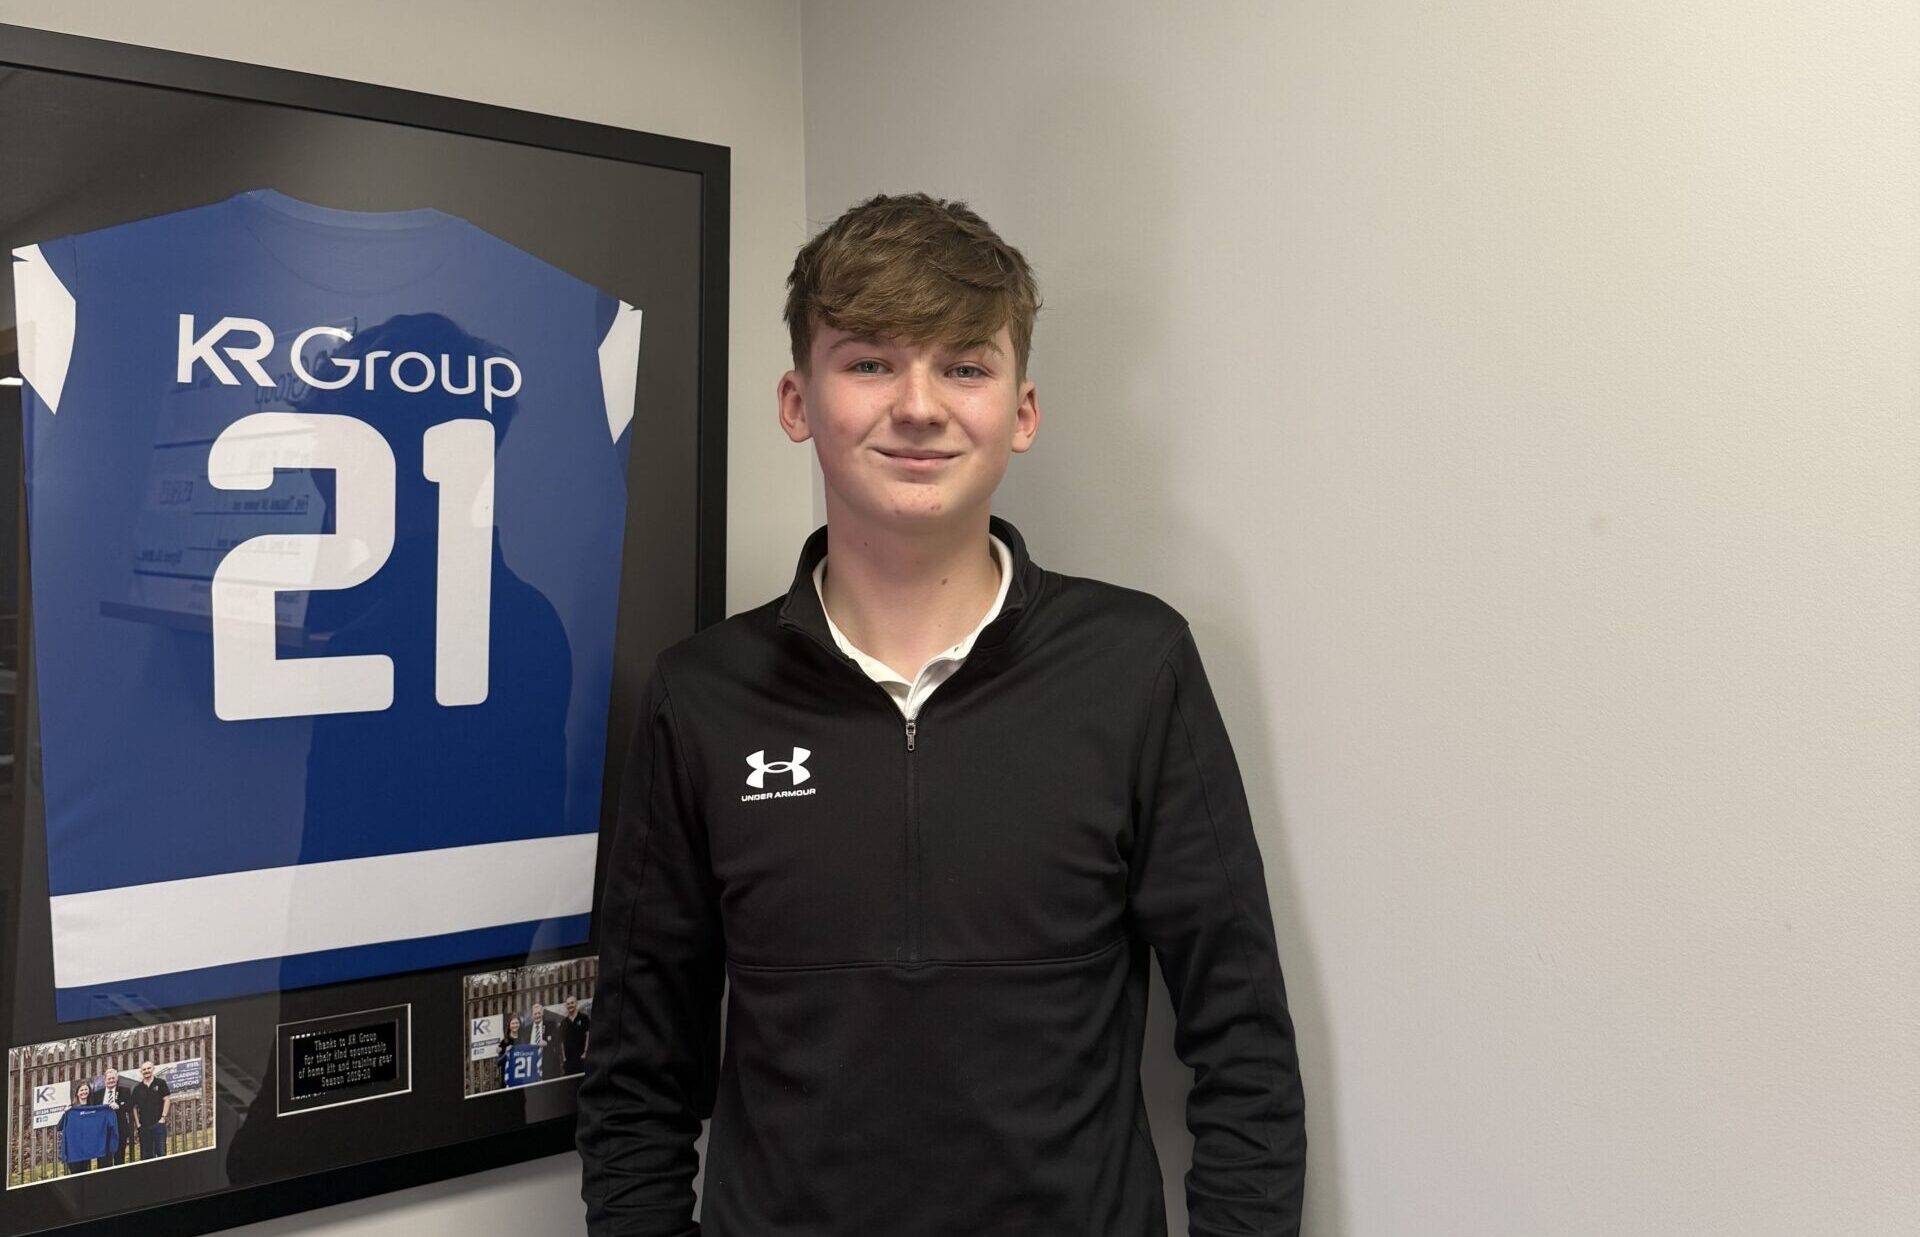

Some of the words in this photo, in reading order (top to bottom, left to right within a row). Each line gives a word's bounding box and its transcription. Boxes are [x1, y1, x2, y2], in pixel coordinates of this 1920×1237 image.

[176, 313, 278, 388] KR
[289, 326, 523, 414] Group
[207, 411, 496, 720] 21
[741, 792, 773, 802] UNDER
[774, 788, 816, 798] ARMOUR
[314, 1039, 337, 1051] Thanks
[339, 1037, 346, 1047] to
[348, 1034, 356, 1045] KR
[359, 1032, 377, 1043] Group
[304, 1055, 314, 1065] for
[316, 1051, 332, 1064] their
[334, 1048, 347, 1060] kind
[349, 1042, 387, 1057] sponsorship
[298, 1068, 305, 1079] of
[307, 1066, 324, 1077] home
[326, 1063, 336, 1073] kit
[338, 1061, 349, 1071] and
[352, 1056, 377, 1069] training
[379, 1054, 393, 1066] gear
[514, 1056, 532, 1078] 21
[321, 1076, 344, 1087] Season
